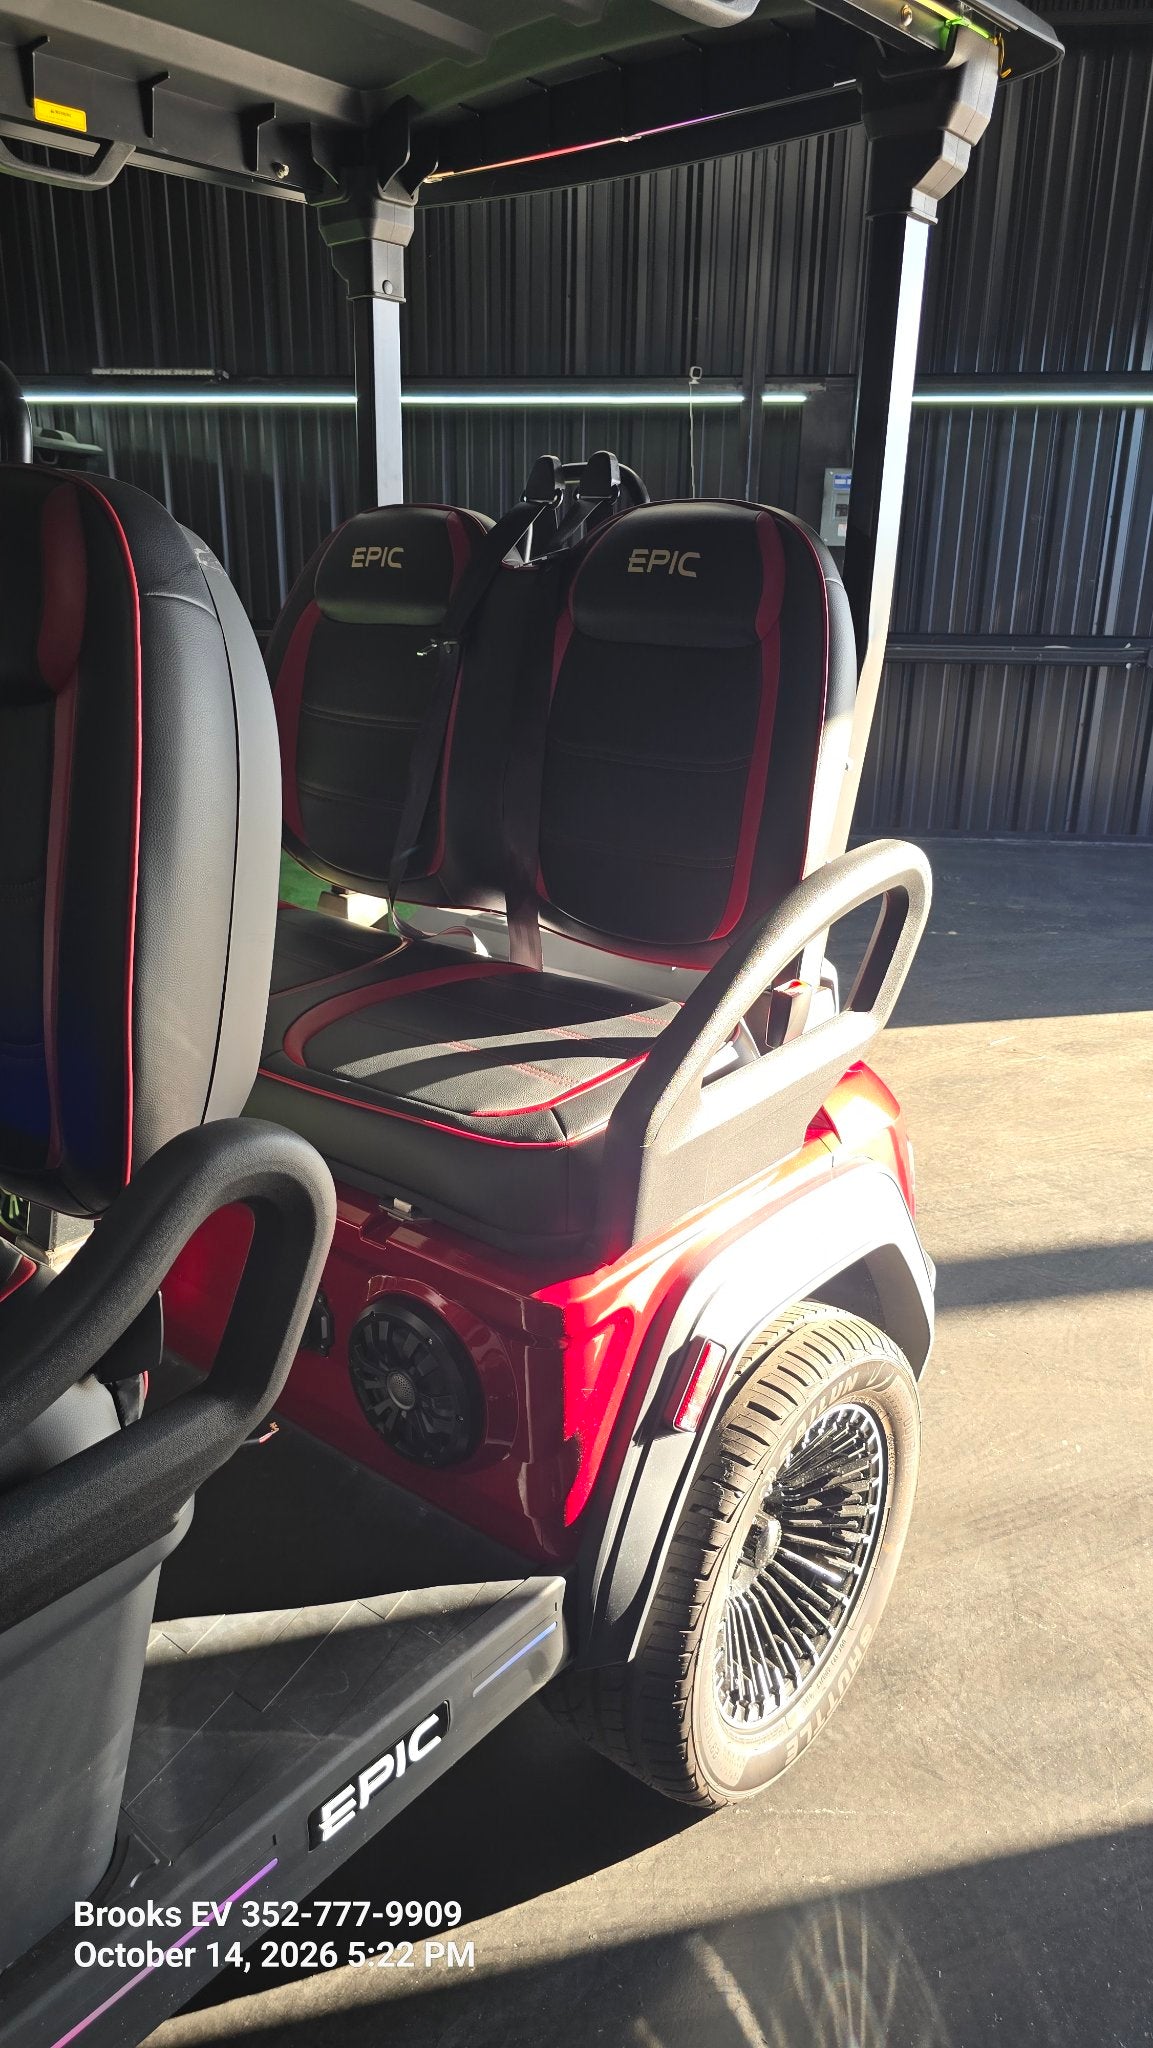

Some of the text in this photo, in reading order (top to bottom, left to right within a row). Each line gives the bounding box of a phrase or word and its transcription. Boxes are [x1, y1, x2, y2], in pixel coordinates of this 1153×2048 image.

[351, 546, 404, 569] EPIC
[627, 548, 701, 578] EPIC
[784, 1623, 873, 1766] SHUTTLE
[318, 1713, 442, 1842] EPIC
